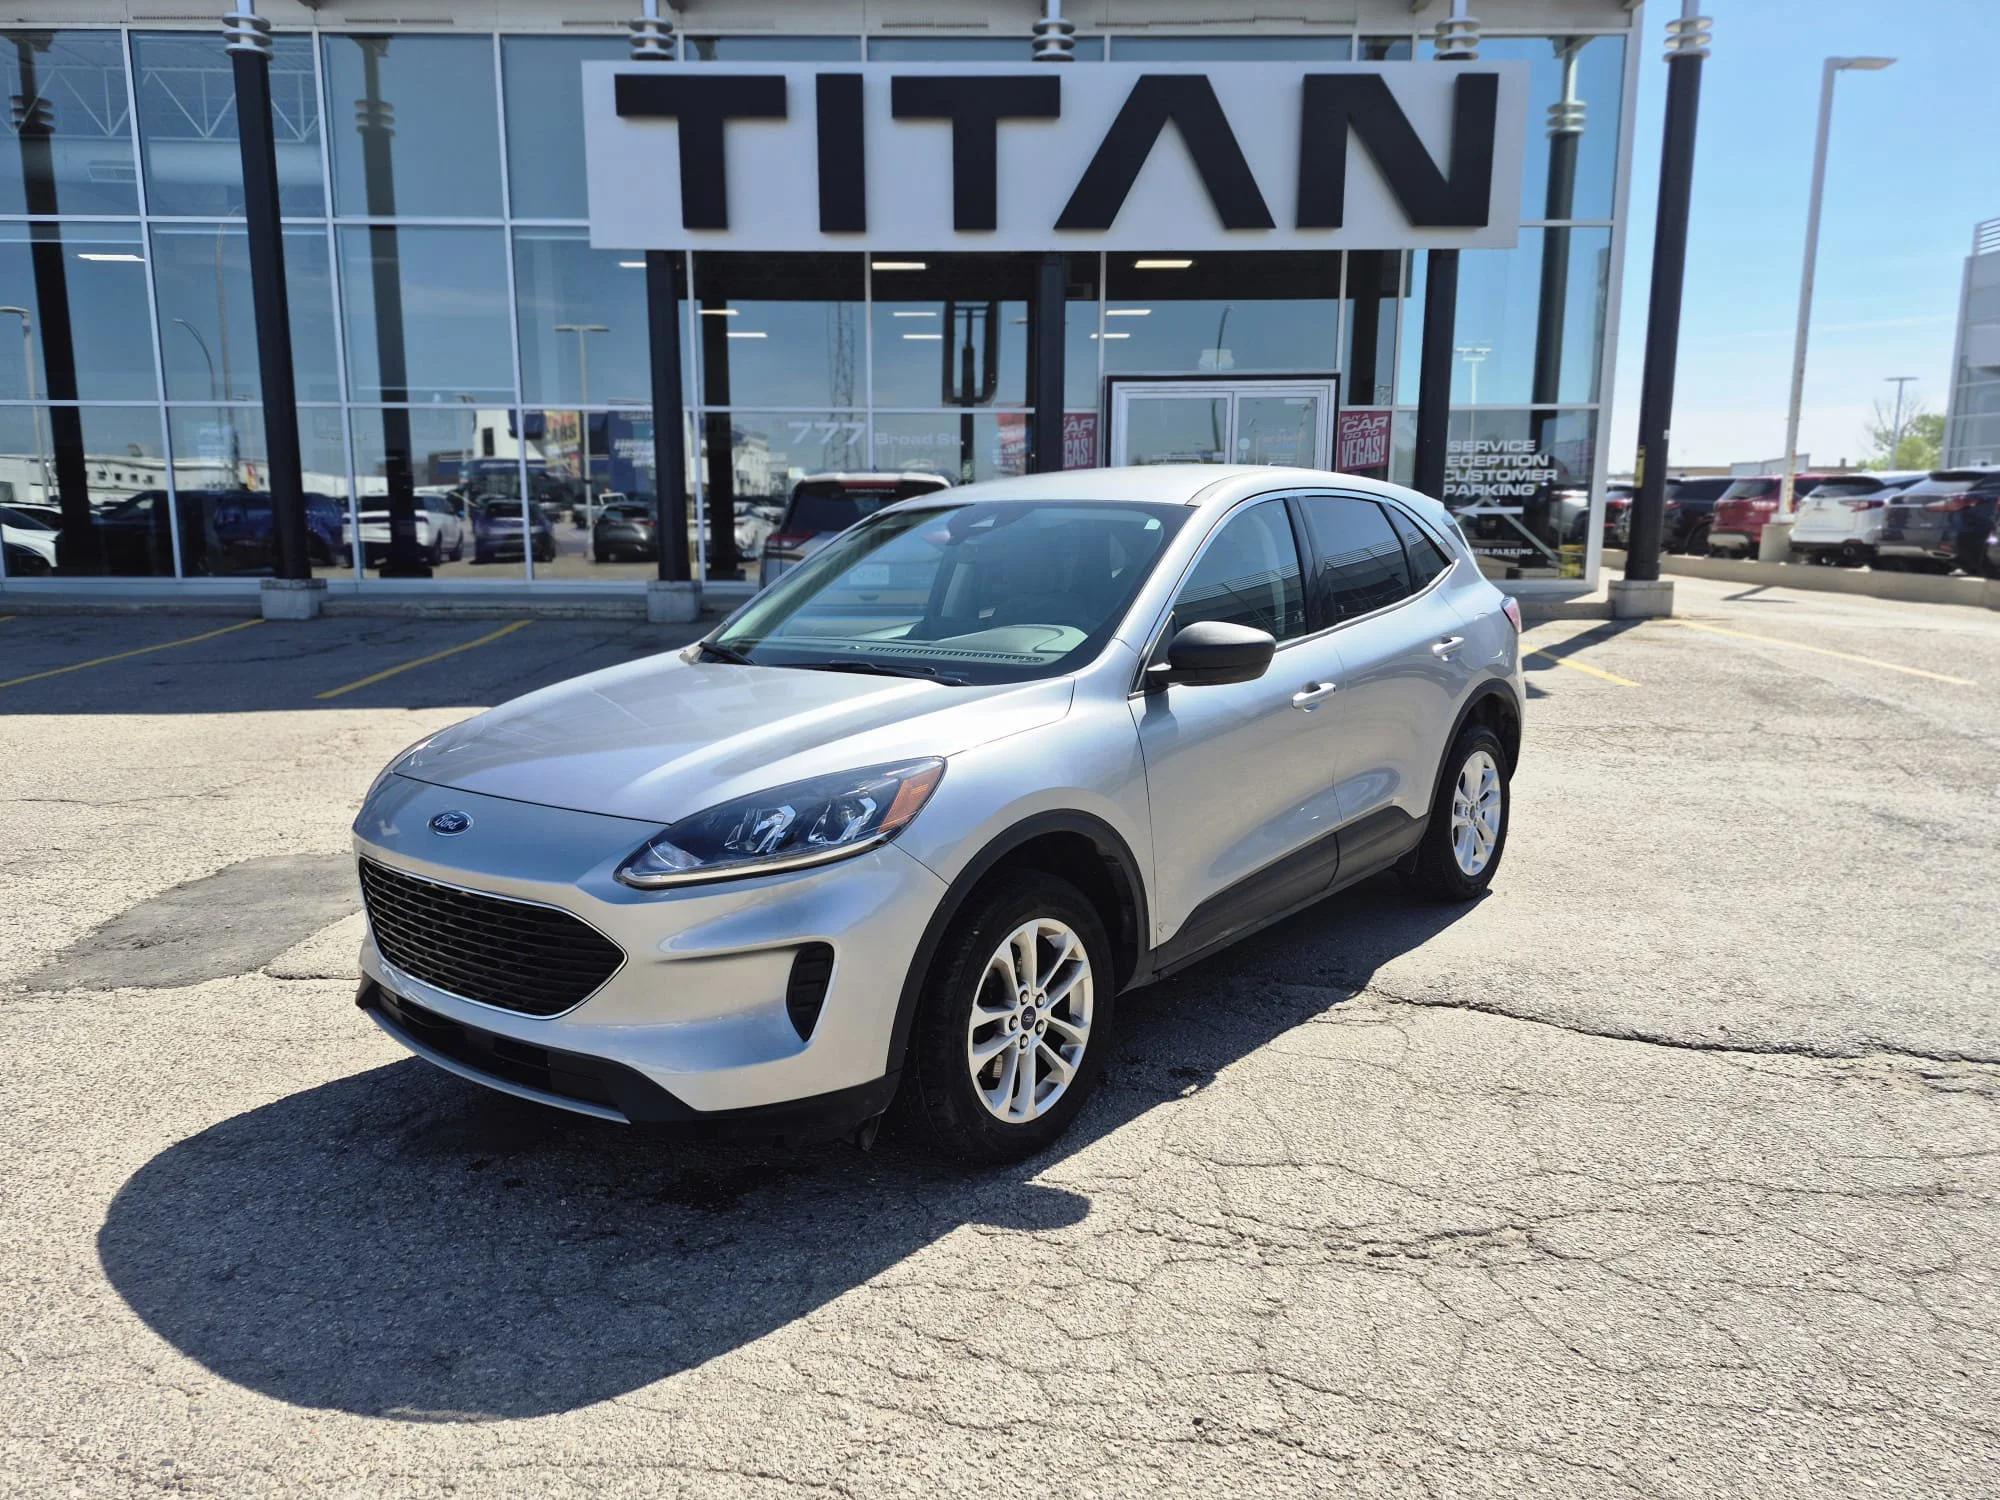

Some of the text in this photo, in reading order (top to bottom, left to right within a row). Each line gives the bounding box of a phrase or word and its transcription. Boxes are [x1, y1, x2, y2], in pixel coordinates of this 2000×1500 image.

[614, 72, 1499, 233] TITAN
[1064, 418, 1095, 432] AR
[1343, 416, 1388, 433] CAR
[787, 421, 965, 445] 777 Broad St.
[1343, 428, 1380, 440] GO TO
[1064, 437, 1093, 468] GAS!
[1341, 434, 1386, 468] VEGAS!
[1448, 439, 1536, 453] SERVICE
[1446, 454, 1549, 467] ECEPTION
[1442, 483, 1535, 497] PARKING
